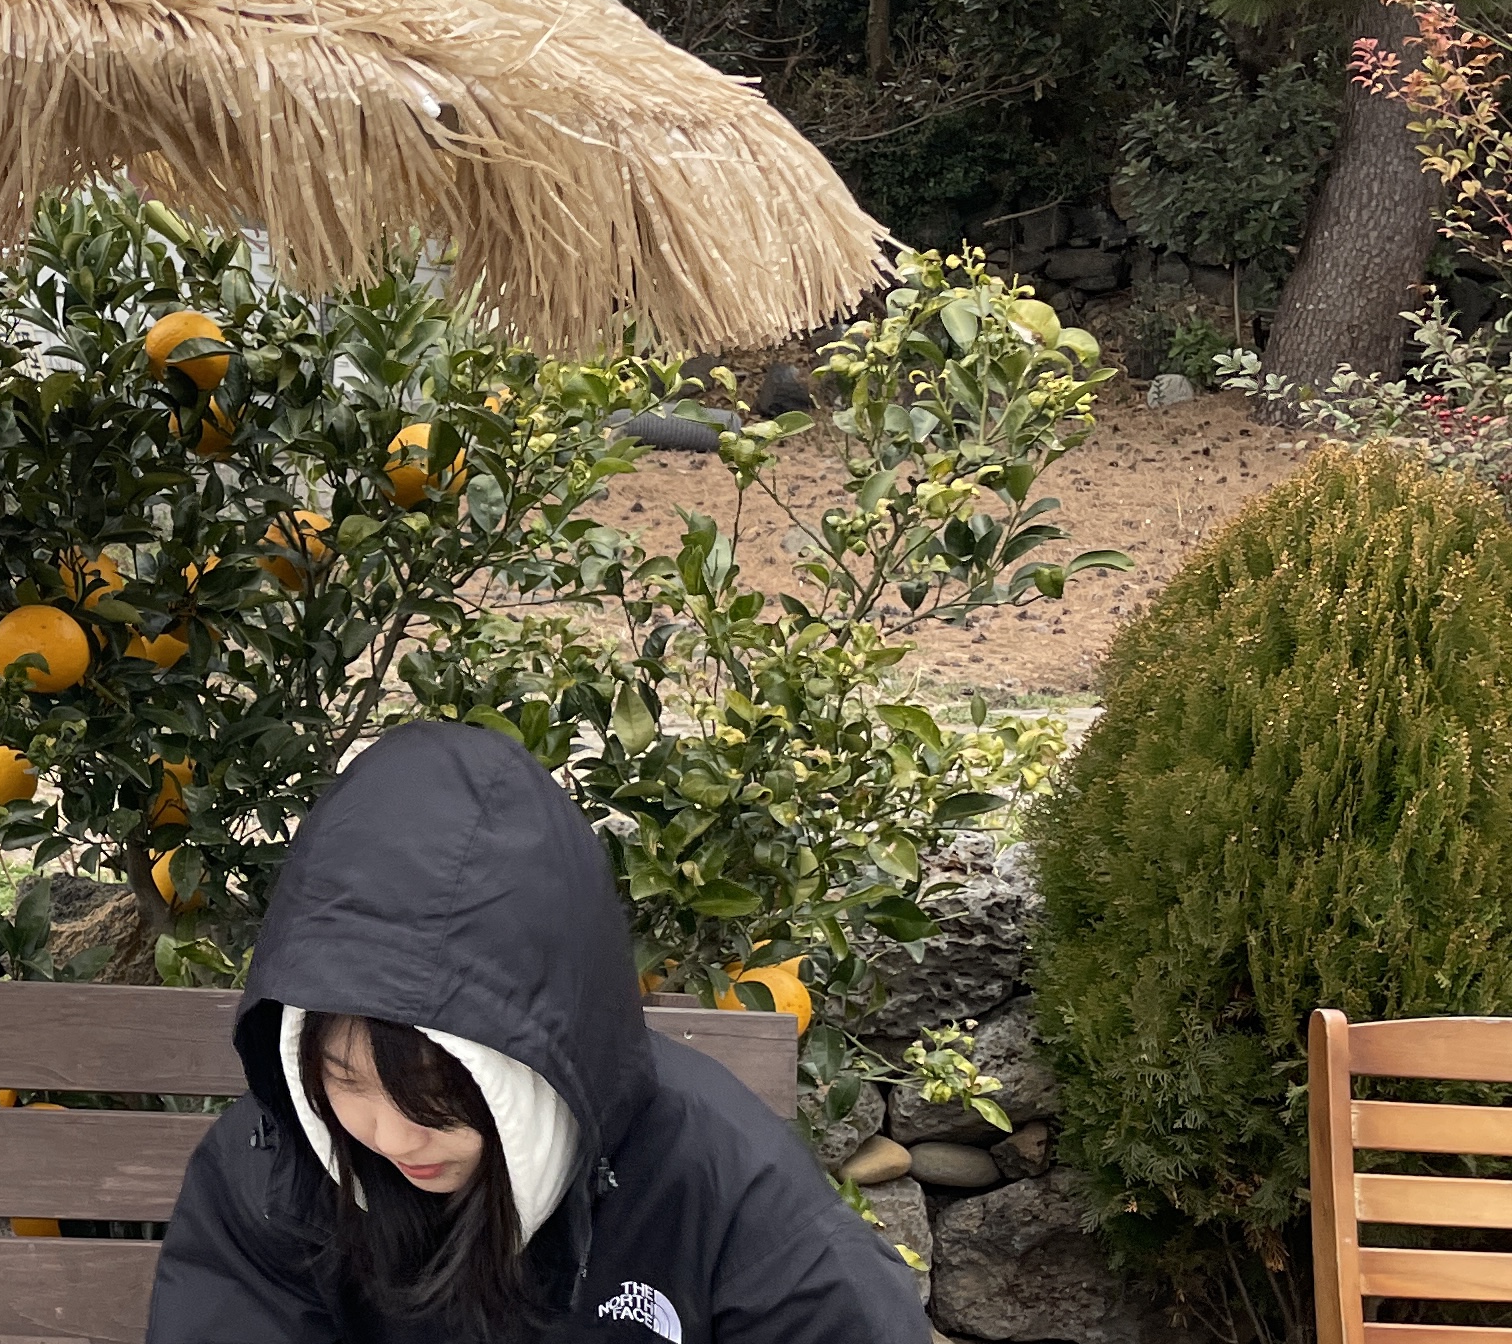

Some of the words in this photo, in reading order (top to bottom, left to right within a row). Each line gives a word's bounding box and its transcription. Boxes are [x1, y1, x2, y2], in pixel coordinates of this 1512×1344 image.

[620, 1280, 654, 1298] THE
[598, 1293, 654, 1318] NORTH
[612, 1306, 654, 1330] FACE
